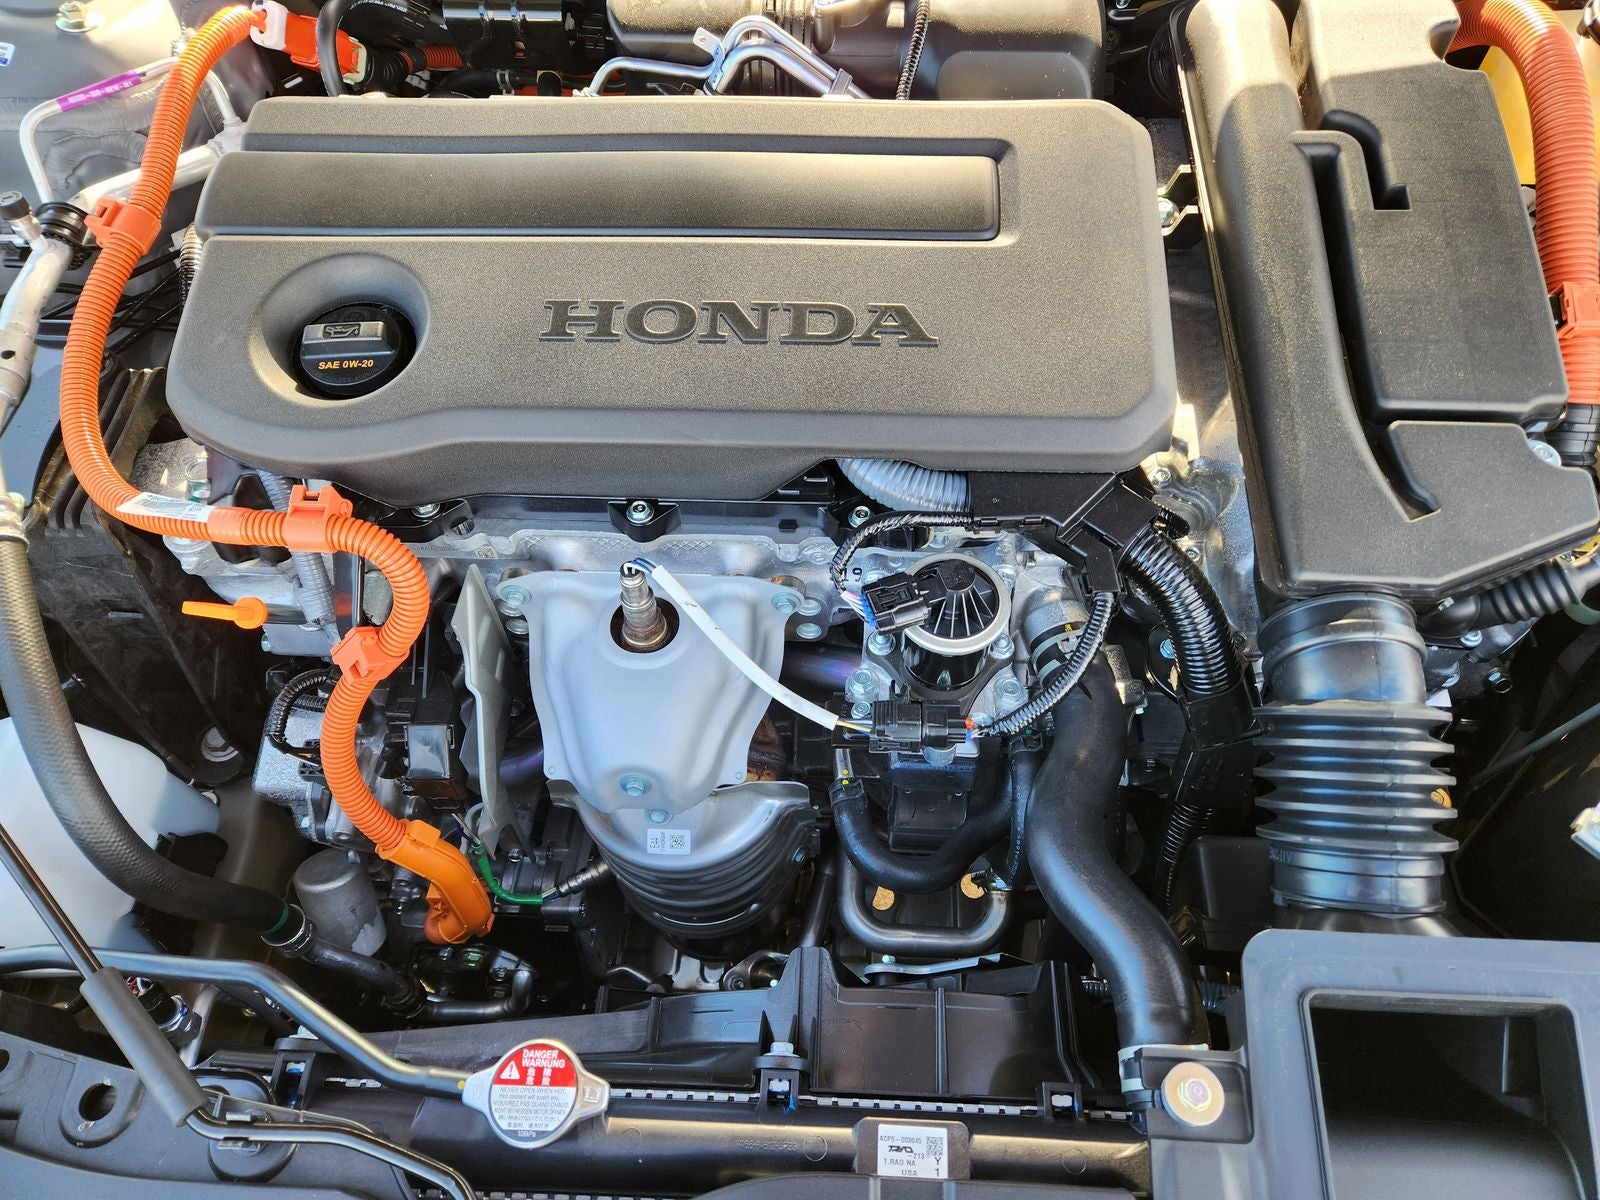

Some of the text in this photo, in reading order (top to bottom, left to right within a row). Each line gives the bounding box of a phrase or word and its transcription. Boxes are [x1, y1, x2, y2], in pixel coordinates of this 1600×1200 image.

[539, 299, 939, 347] HONDA
[318, 359, 374, 370] SAE 0W-20
[522, 1049, 558, 1059] DANGER
[522, 1058, 565, 1068] WARNUNG
[934, 1156, 942, 1165] Y
[934, 1168, 940, 1177] 1
